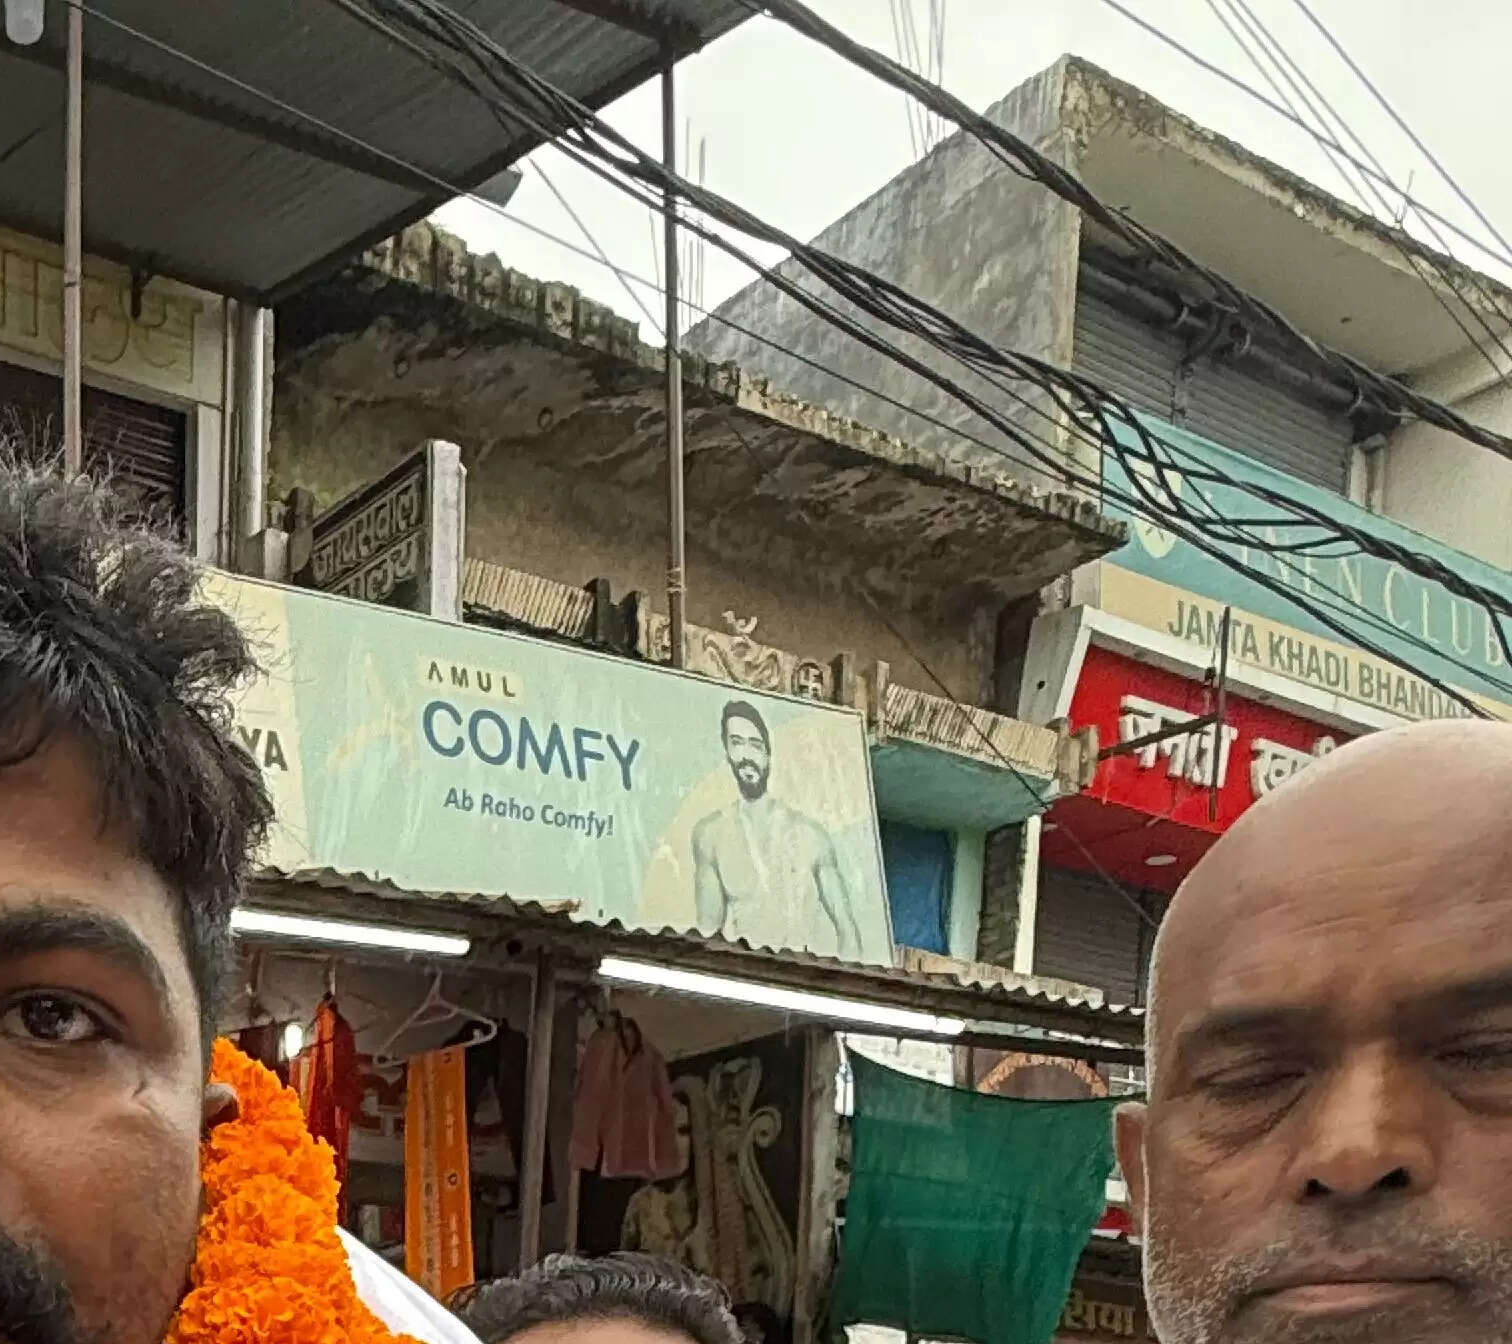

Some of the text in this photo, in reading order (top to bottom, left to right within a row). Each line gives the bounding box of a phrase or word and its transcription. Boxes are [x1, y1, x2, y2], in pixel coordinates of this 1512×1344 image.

[427, 661, 516, 698] AMUL
[1267, 630, 1350, 692] KHADI
[239, 725, 288, 772] YA
[423, 700, 640, 791] COMFY
[443, 787, 614, 840] Ab Raho Comfy!
